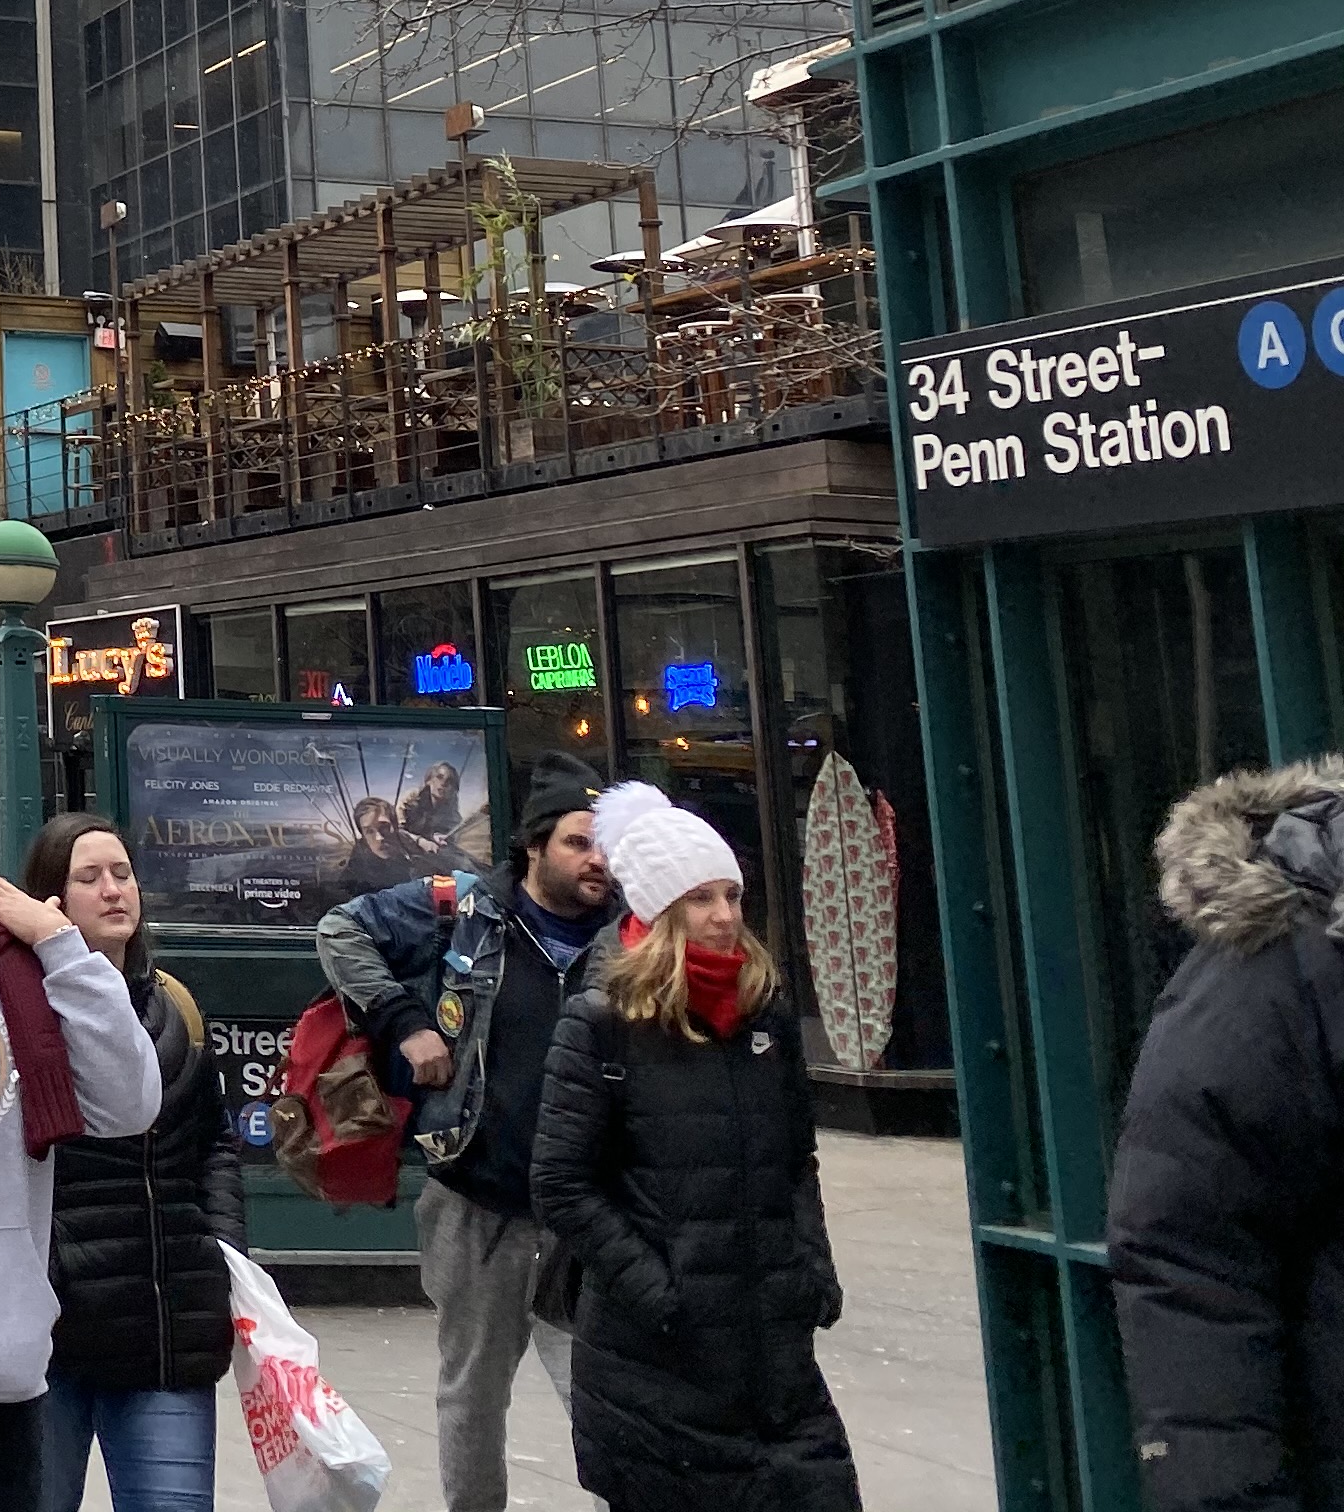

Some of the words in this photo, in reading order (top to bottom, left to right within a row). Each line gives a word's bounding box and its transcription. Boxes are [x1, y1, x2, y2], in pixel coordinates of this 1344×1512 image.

[1257, 321, 1290, 370] A
[908, 359, 971, 422] 34
[912, 433, 1026, 490] Penn
[1043, 399, 1232, 474] Station
[49, 620, 174, 695] Lucy's
[415, 654, 473, 694] Modelo
[138, 745, 224, 764] VISUALLY
[229, 748, 338, 768] WONDROUS
[144, 779, 187, 790] FELICITY
[189, 780, 220, 791] JONES
[253, 782, 281, 793] EDDIE
[283, 783, 334, 794] REDMAYNE
[139, 815, 352, 849] AERONAUTS
[189, 883, 234, 893] DECEMBER
[244, 888, 273, 899] prime
[274, 888, 301, 899] video
[252, 878, 284, 886] THEATERS
[209, 1022, 294, 1057] Stree
[249, 1111, 267, 1136] E
